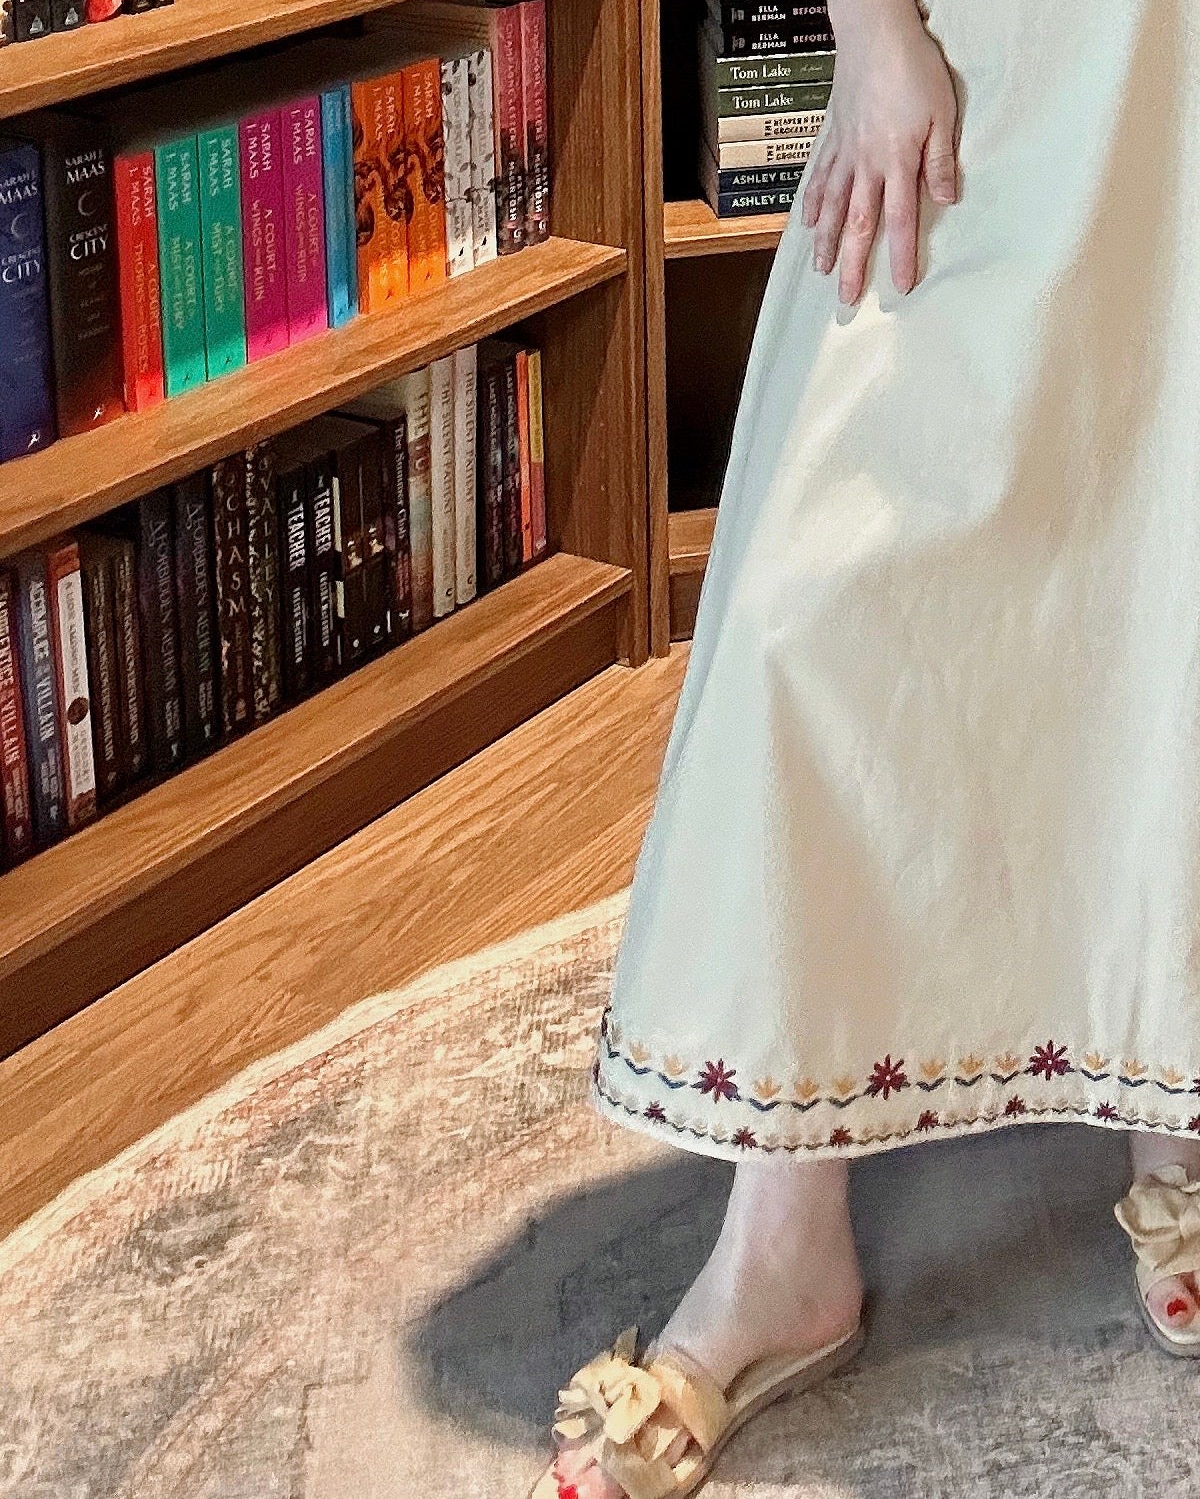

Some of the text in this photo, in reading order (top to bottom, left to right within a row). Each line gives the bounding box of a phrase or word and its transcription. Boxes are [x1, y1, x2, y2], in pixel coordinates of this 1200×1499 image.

[730, 64, 791, 80] Tom Lake
[732, 94, 793, 109] Tom Lake
[260, 123, 272, 171] SARAH
[292, 121, 302, 165] MAAS
[303, 110, 315, 157] SARAH
[66, 165, 105, 185] MAAS
[180, 152, 192, 204] SARAH
[209, 151, 219, 197] MAAS
[221, 139, 232, 189] SARAH
[249, 135, 259, 179] MAAS
[732, 173, 776, 185] ASHLEY
[130, 179, 140, 226] MAAS
[168, 165, 179, 211] MAAS
[732, 194, 776, 207] ASHLEY
[2, 259, 41, 283] CITY
[70, 236, 109, 261] CITY
[395, 452, 407, 540] Summer Club
[288, 502, 306, 572] TEACHER
[314, 489, 332, 556] TEACHER
[37, 677, 54, 742] VILLAIN
